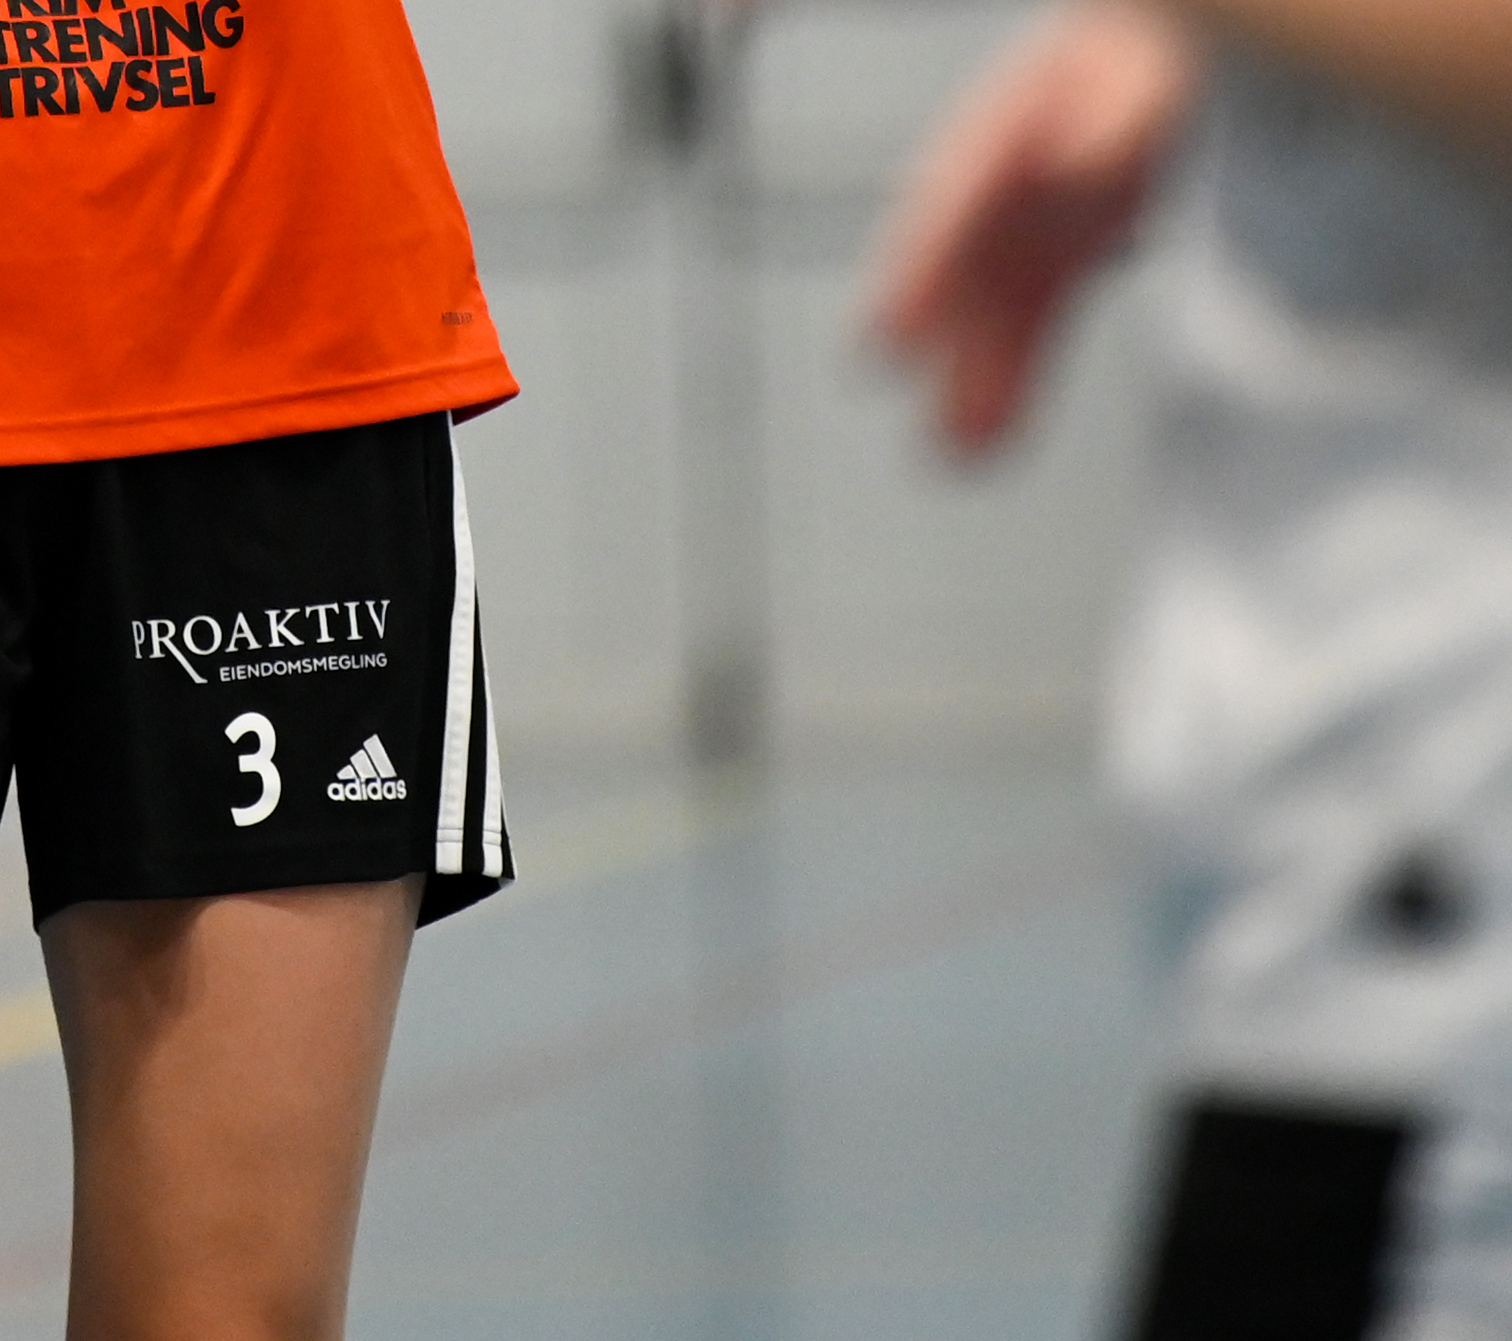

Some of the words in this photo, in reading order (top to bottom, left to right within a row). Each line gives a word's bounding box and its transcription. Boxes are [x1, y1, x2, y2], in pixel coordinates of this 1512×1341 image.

[132, 599, 391, 685] PROAKTIV
[219, 652, 388, 683] EIENDOMSMEGLING
[224, 711, 282, 828] 3
[326, 777, 407, 803] adidas
